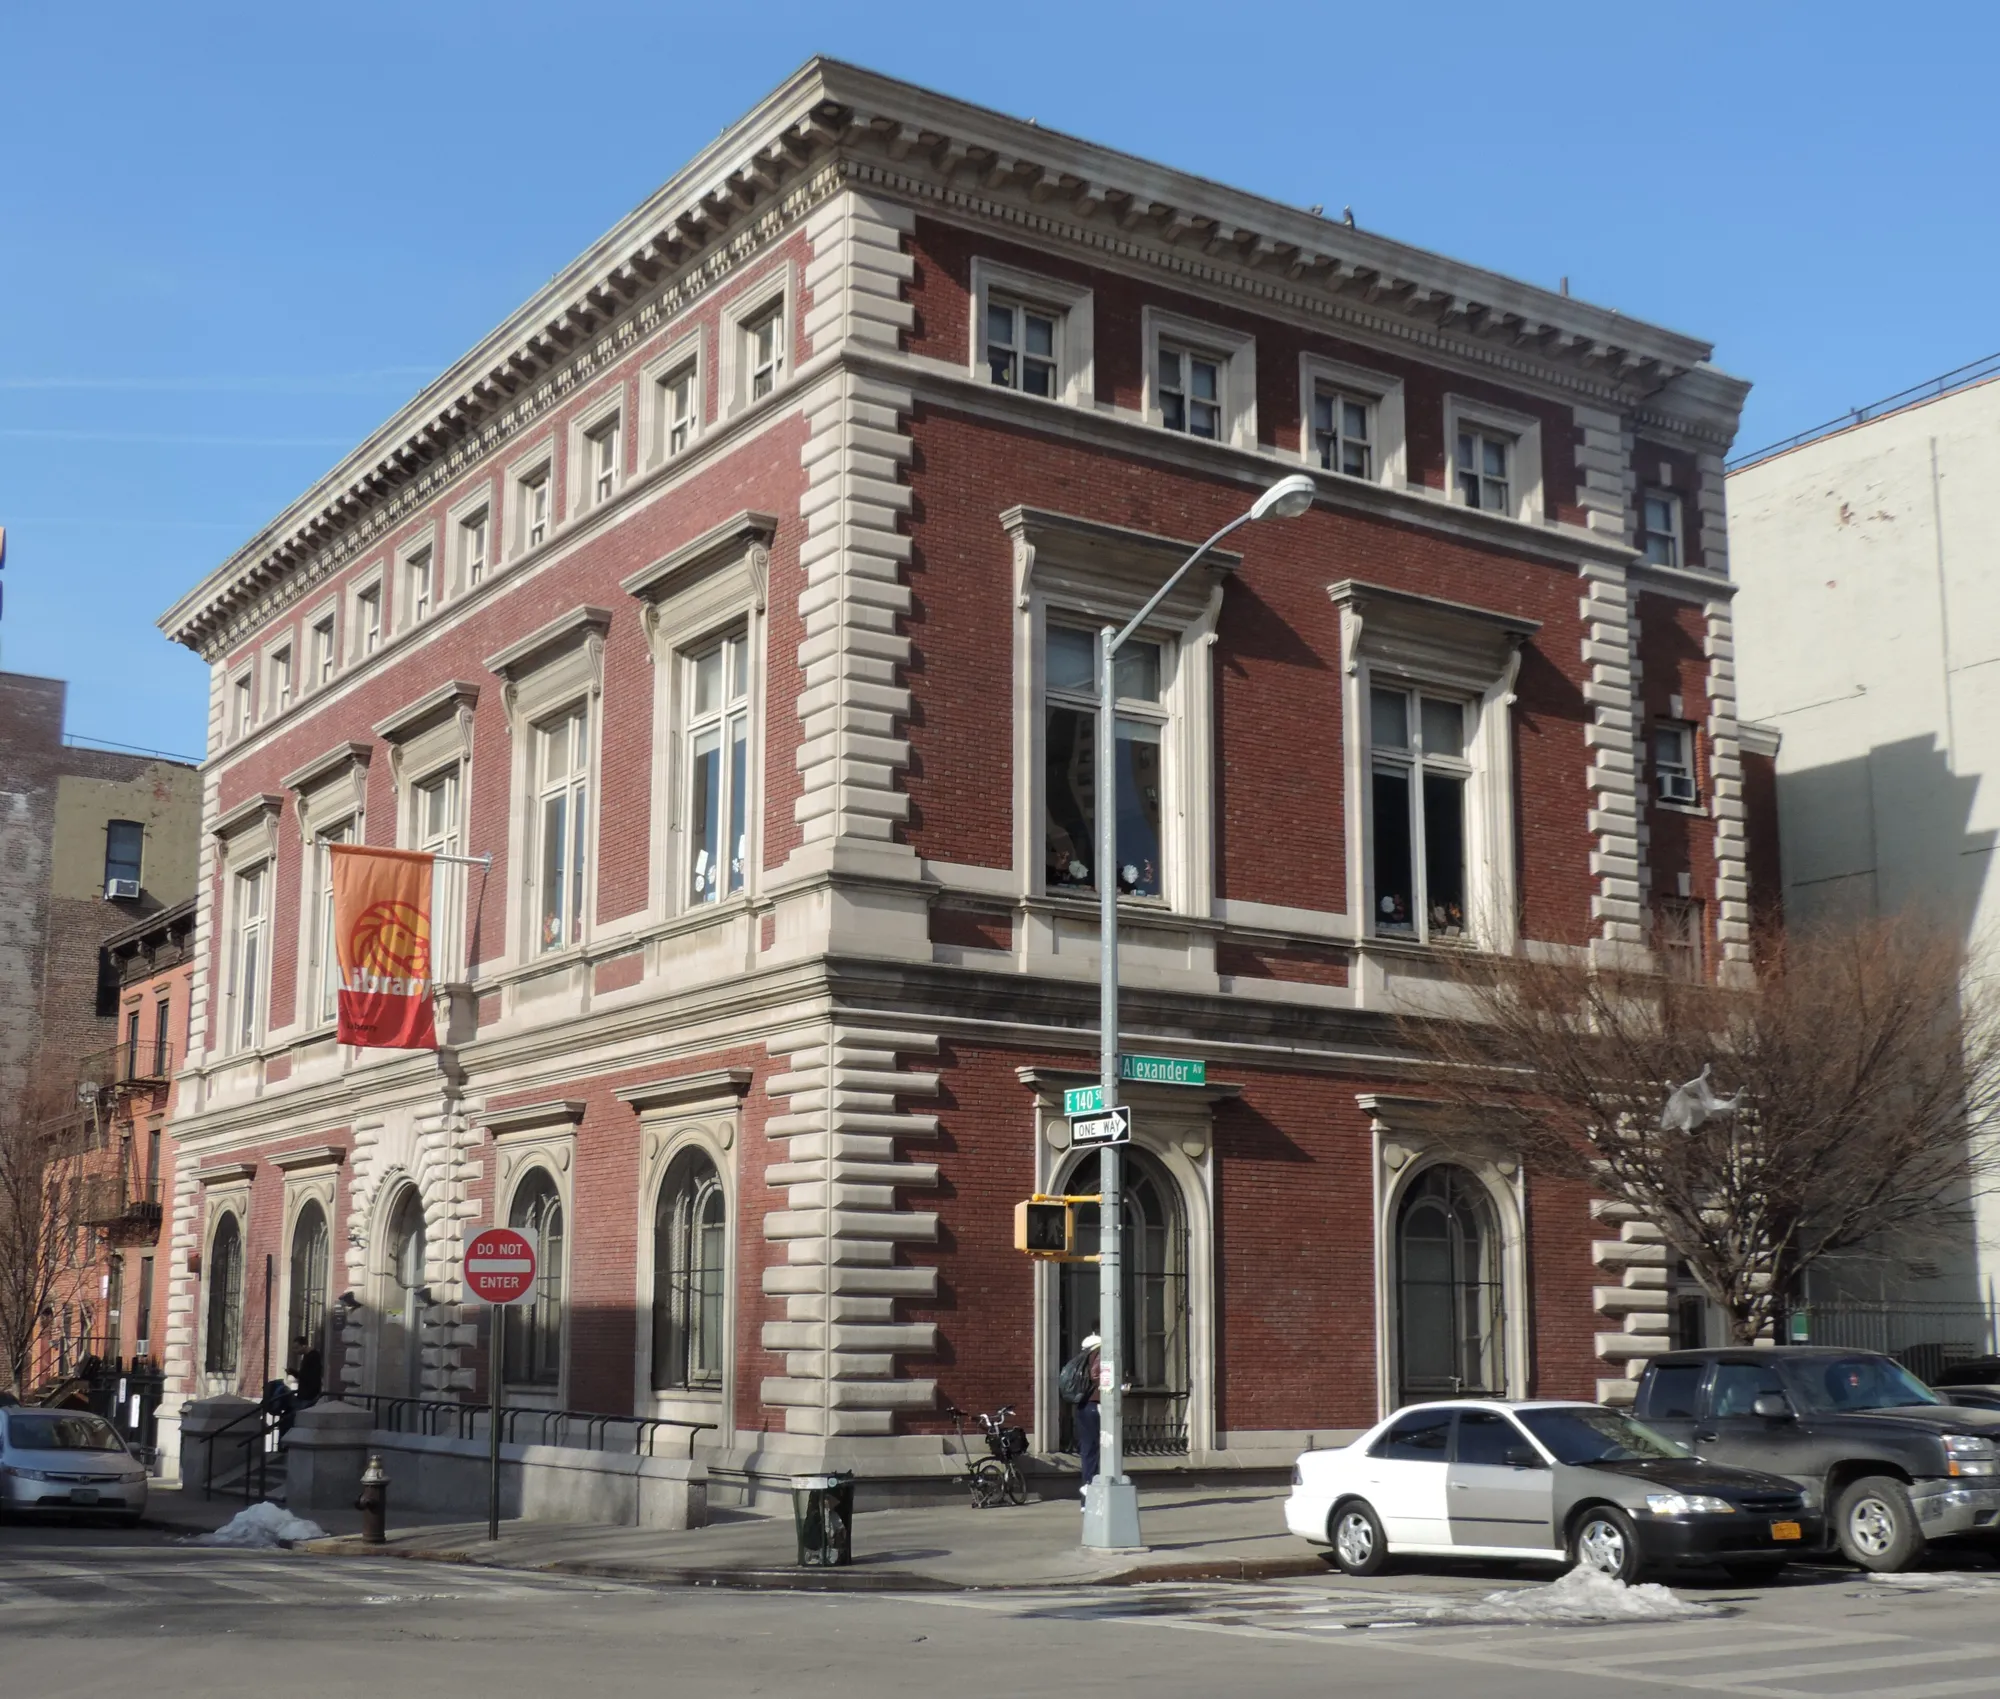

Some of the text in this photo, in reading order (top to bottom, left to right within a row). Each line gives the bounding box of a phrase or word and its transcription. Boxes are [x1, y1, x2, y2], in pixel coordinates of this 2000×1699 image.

[337, 965, 432, 1003] Library
[1123, 1058, 1187, 1080] Alexander
[1066, 1093, 1072, 1112] E
[1075, 1090, 1093, 1110] 140
[1079, 1119, 1120, 1136] ONE WAY
[477, 1243, 522, 1254] DO NOT
[480, 1276, 519, 1288] ENTER
